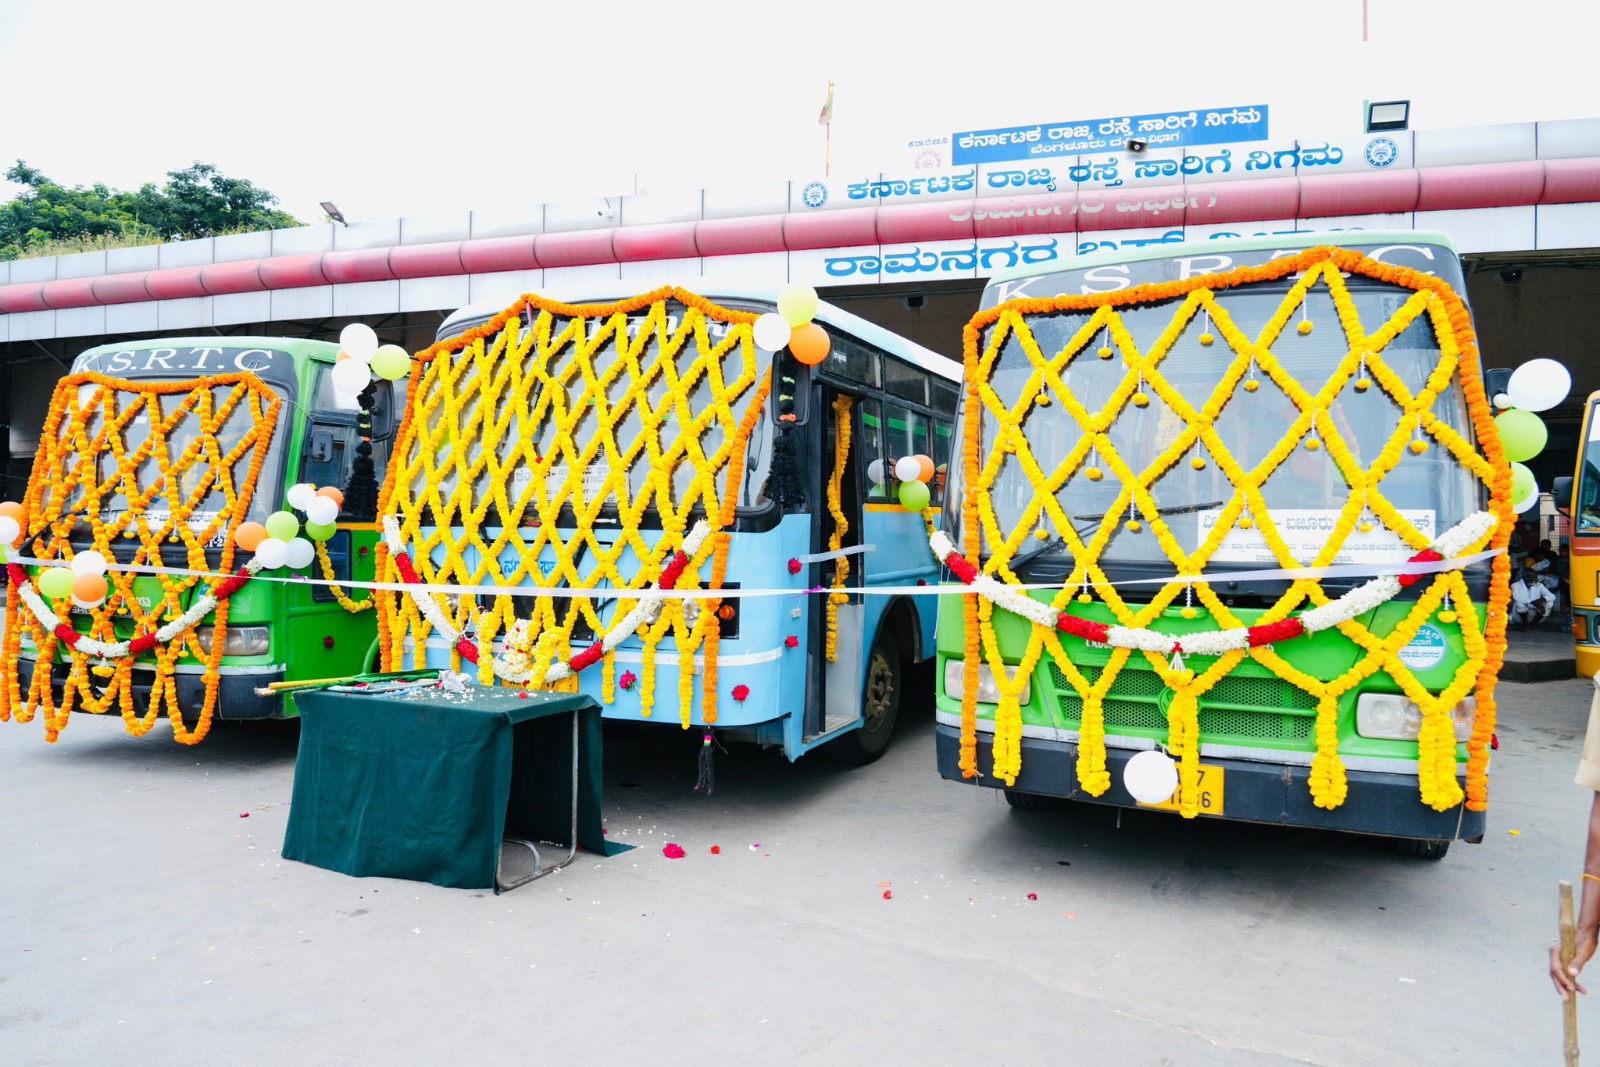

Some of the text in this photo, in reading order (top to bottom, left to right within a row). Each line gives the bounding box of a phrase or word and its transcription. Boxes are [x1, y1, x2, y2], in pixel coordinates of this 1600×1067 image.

[958, 107, 1262, 149] ಕರ್ನಾಟಕ ರಾಜ್ಯ ರಸ್ತೆ ಸಾರಿಗೆ ನಿಗಮ
[847, 168, 976, 200] ಕರ್ನಾಟಕ
[987, 167, 1057, 192] ರಾಜ್ಯ
[1068, 156, 1123, 188] ರಸ್ತೆ
[1134, 148, 1233, 179] ಸಾರಿಗೆ
[1245, 141, 1344, 171] ನಿಗಮ
[824, 237, 1059, 277] ರಾಮನಗರ
